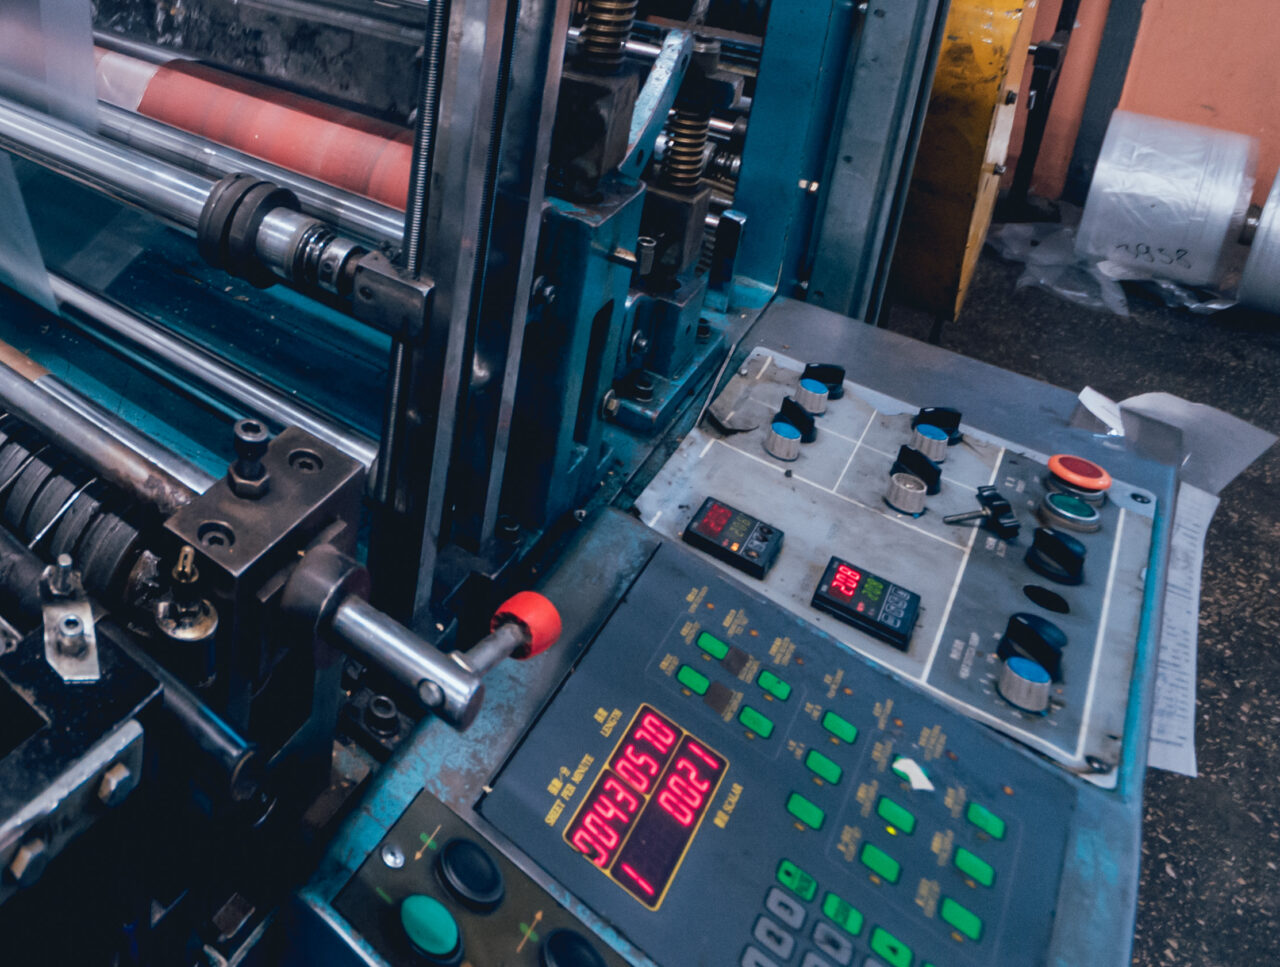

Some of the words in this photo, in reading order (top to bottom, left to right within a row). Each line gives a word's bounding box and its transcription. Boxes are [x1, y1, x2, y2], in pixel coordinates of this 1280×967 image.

[832, 564, 861, 597] 208
[600, 708, 623, 738] LENGTH
[615, 713, 676, 793] 0570
[544, 799, 566, 827] SHEET
[561, 783, 577, 801] PER
[571, 753, 595, 784] MINUTE
[722, 782, 744, 814] SCALAR
